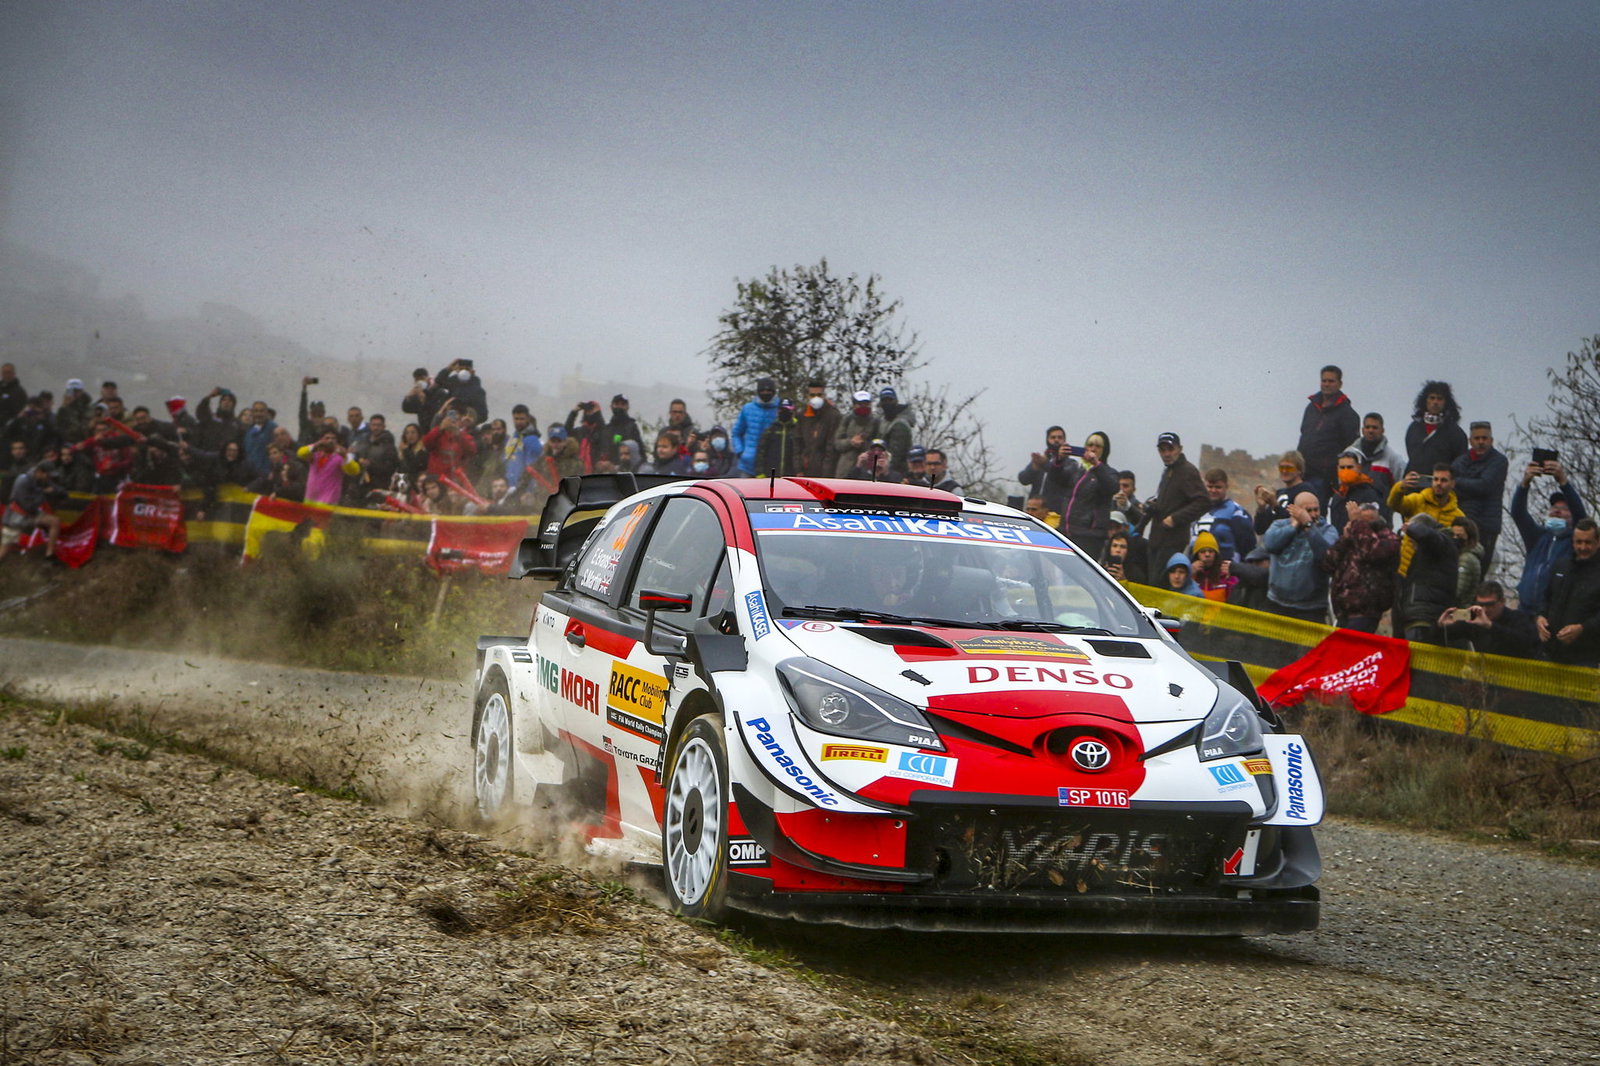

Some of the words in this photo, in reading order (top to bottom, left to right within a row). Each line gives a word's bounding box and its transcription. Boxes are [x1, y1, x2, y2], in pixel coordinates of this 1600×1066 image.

[134, 504, 156, 517] GR
[809, 507, 889, 515] TOYOTA
[894, 511, 964, 521] GAZOO
[1320, 651, 1383, 682] TOYOTA
[966, 666, 1133, 689] DENSO
[1320, 664, 1379, 690] GAZOO
[562, 668, 600, 716] MORI
[610, 671, 641, 703] RACC
[640, 695, 652, 709] Club
[909, 735, 941, 748] PIAA
[613, 746, 638, 762] TOYOTA
[825, 746, 885, 761] PIRELLI
[1204, 747, 1224, 757] PIAA
[746, 717, 838, 806] Panasonic
[1283, 743, 1308, 820] Panasonic
[1070, 790, 1091, 804] SP
[1095, 791, 1127, 805] 1016
[730, 844, 766, 860] OMP
